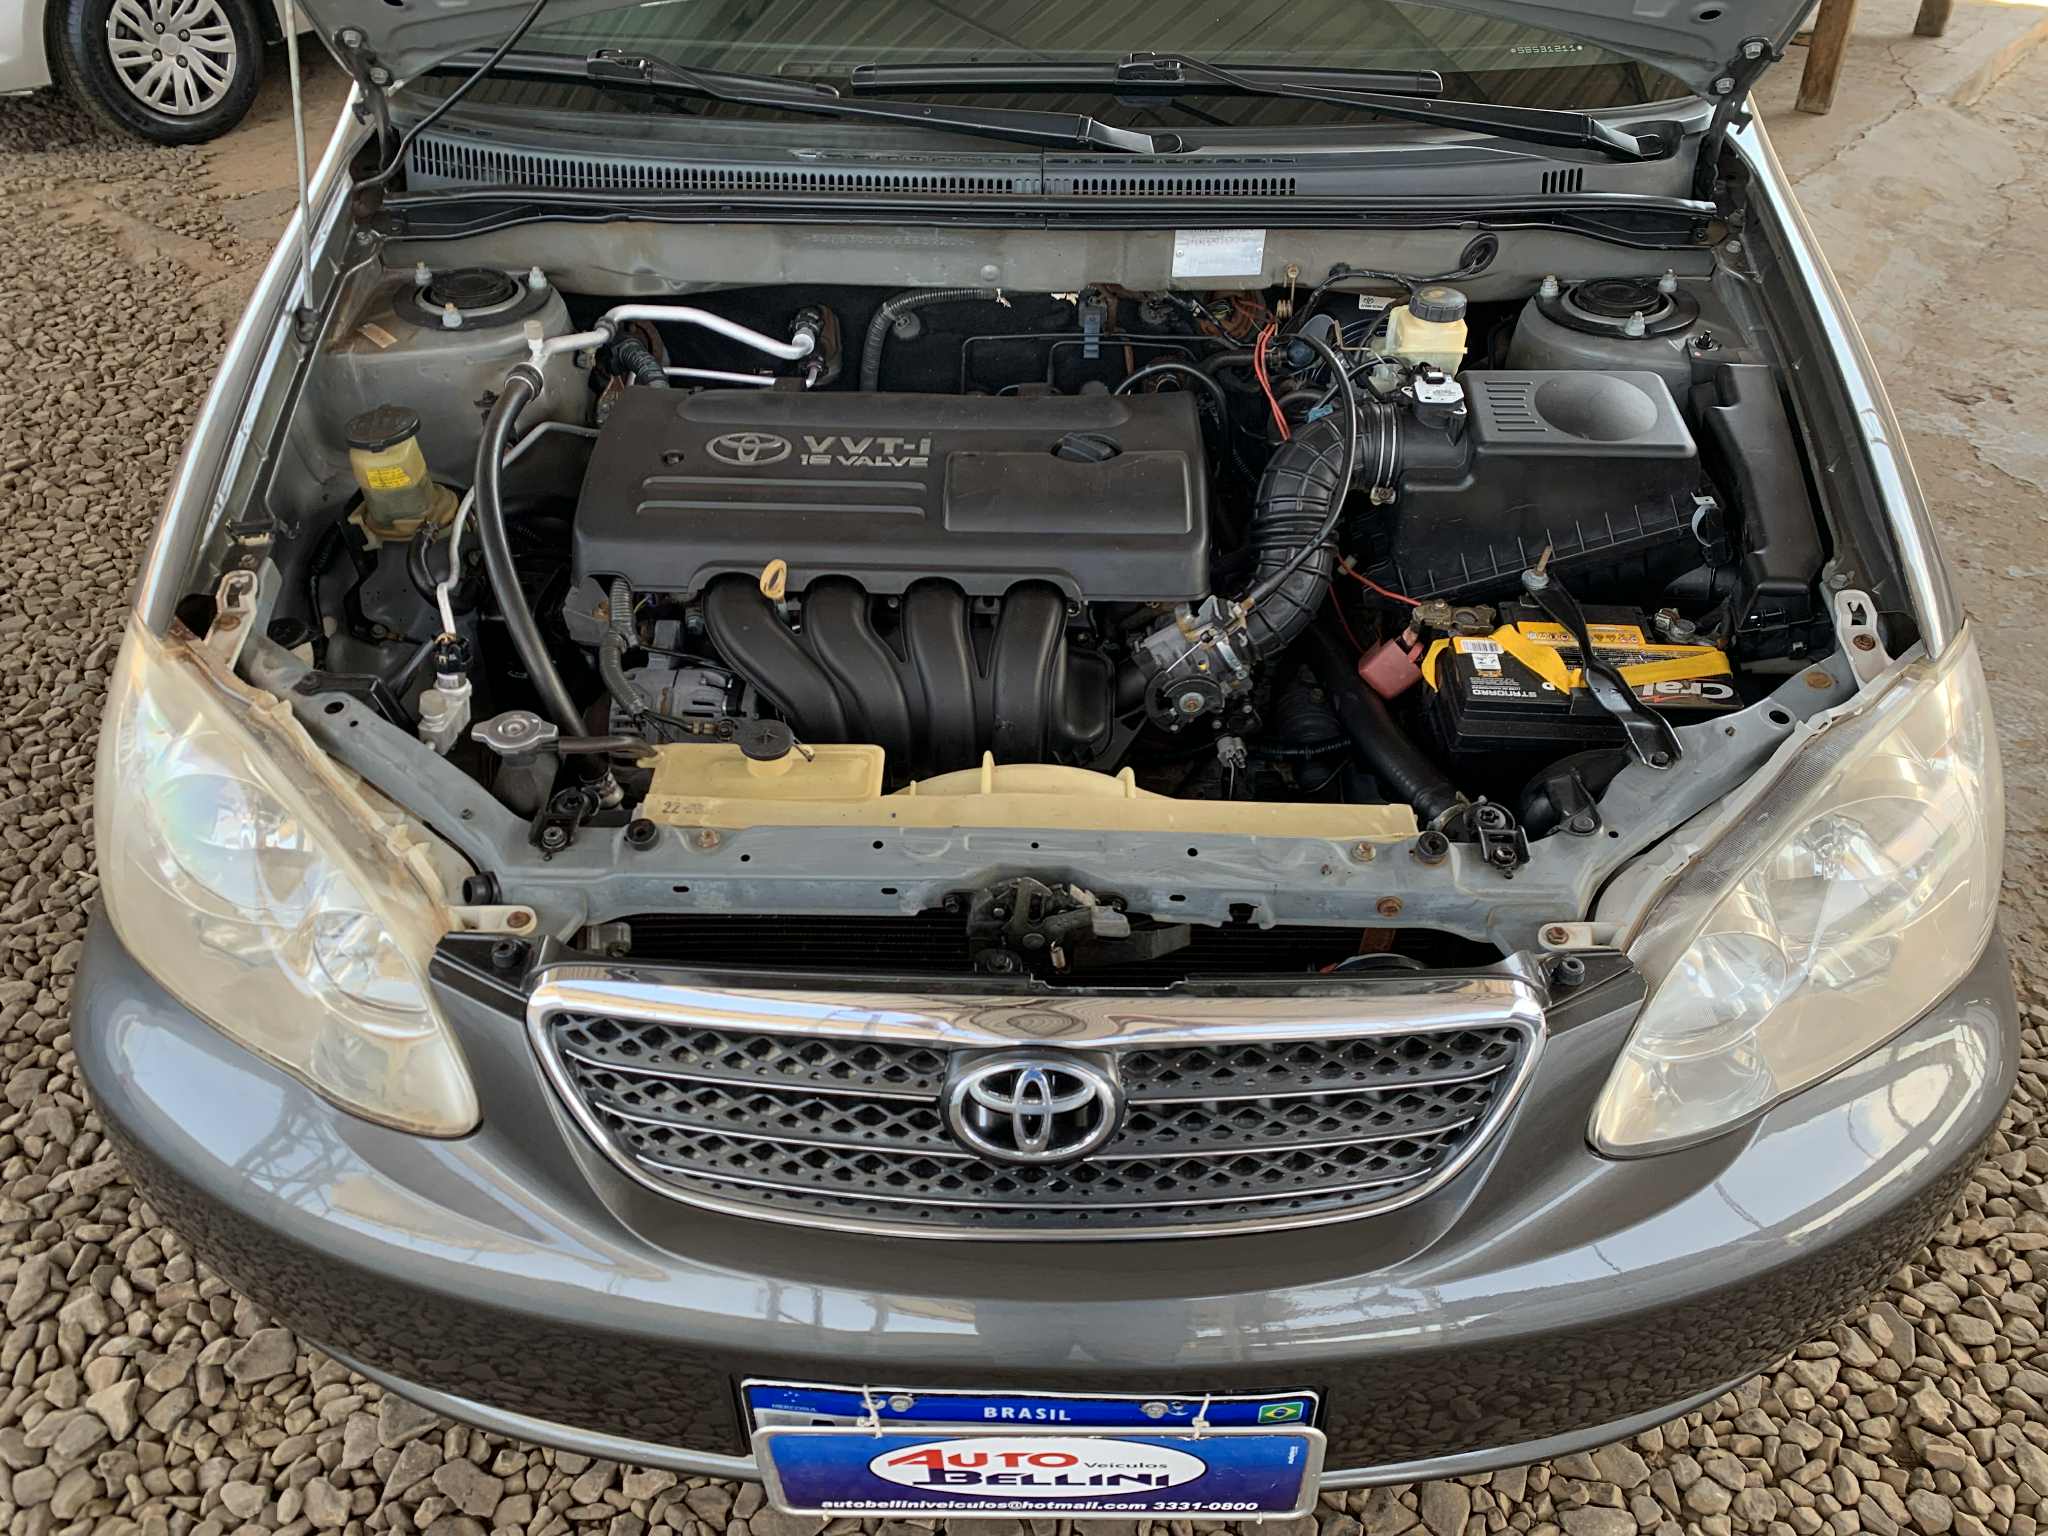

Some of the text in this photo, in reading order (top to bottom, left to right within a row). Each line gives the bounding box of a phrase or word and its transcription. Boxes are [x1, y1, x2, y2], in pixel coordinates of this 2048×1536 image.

[836, 455, 929, 467] VALVE
[1472, 689, 1537, 698] STANDARD
[983, 1406, 1072, 1421] BRASIL
[888, 1449, 1079, 1468] AUTO
[913, 1468, 1170, 1487] BELLINI
[821, 1500, 1259, 1512] autobelliniveiculos@hotmail.com 3331-0800
